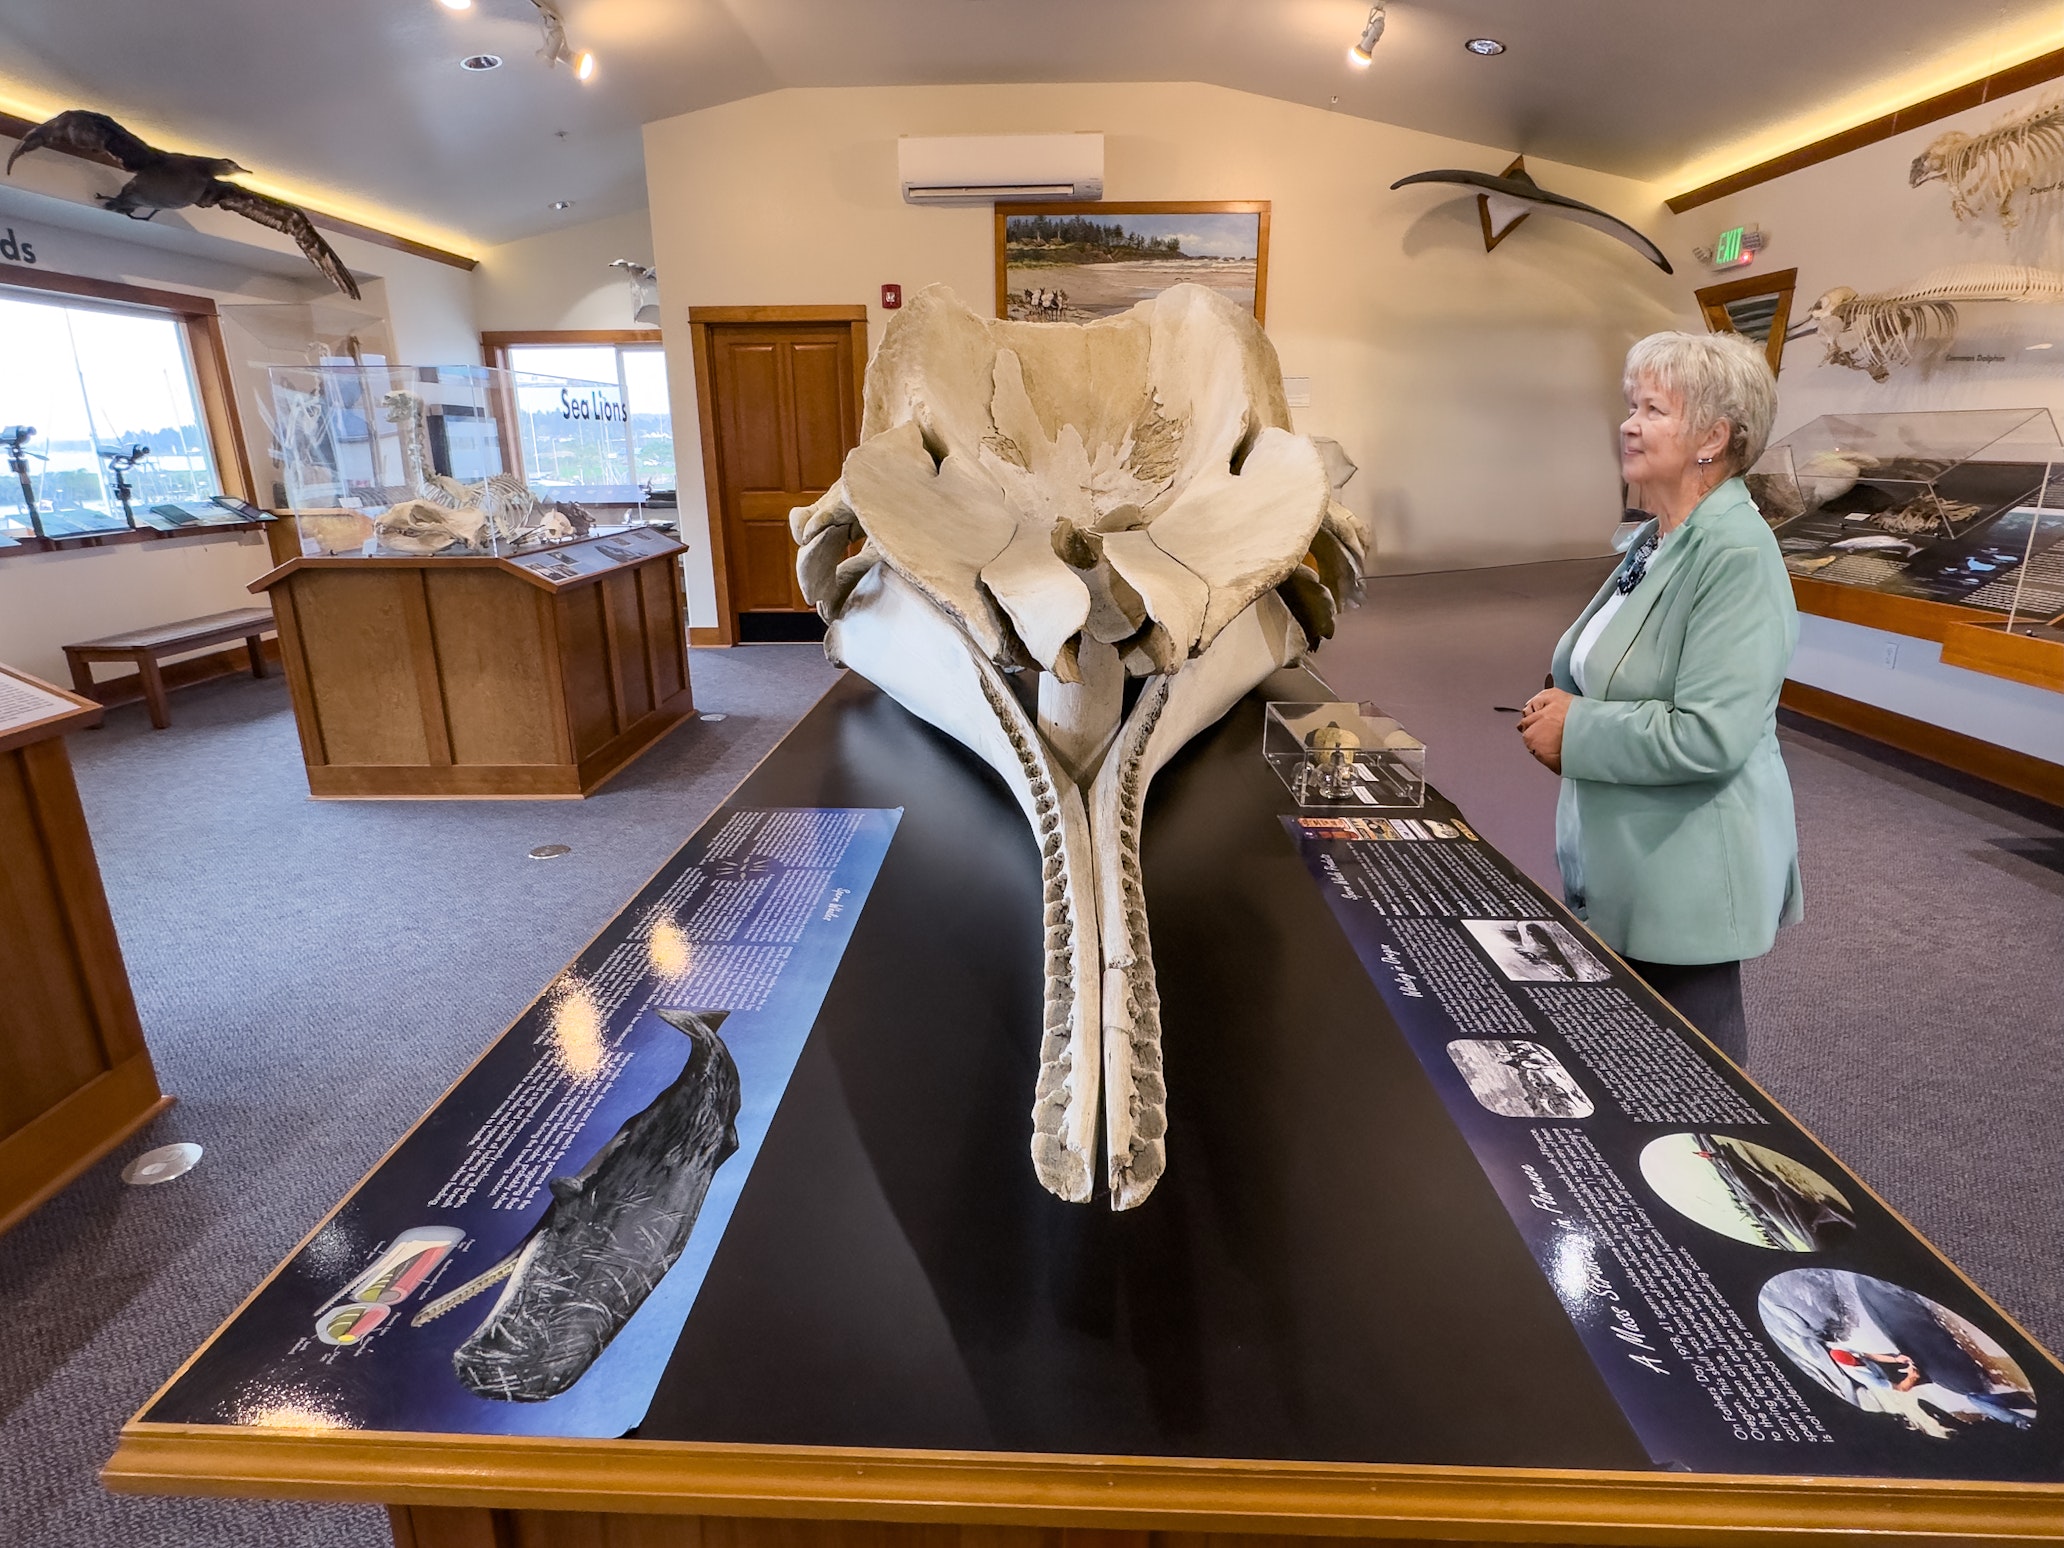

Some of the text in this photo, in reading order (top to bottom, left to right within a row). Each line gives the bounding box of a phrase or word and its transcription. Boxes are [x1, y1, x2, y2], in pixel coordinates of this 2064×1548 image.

[0, 228, 37, 264] ds
[1716, 227, 1744, 264] EXIT
[1945, 354, 2006, 364] Common Dolphin
[561, 388, 628, 423] Sea Lions
[591, 1094, 605, 1107] show
[580, 1108, 593, 1121] scars
[530, 1121, 551, 1138] during
[572, 1122, 585, 1132] that
[525, 1139, 538, 1148] the
[560, 1133, 575, 1150] match
[503, 1148, 532, 1174] breeding
[552, 1151, 565, 1160] the
[1564, 1145, 1581, 1160] years
[535, 1161, 556, 1184] patterns
[526, 1186, 541, 1198] that
[1521, 1164, 1563, 1214] Florence
[1593, 1186, 1608, 1200] from
[1608, 1188, 1627, 1205] years
[517, 1200, 531, 1210] the
[1577, 1198, 1588, 1207] on
[1605, 1202, 1619, 1214] age
[1583, 1207, 1599, 1223] alive
[1595, 1208, 1609, 1219] not
[1633, 1206, 1654, 1228] history
[1595, 1223, 1615, 1246] ashore
[1605, 1220, 1618, 1233] was
[1621, 1224, 1645, 1250] ranging
[1650, 1229, 1673, 1252] human
[1611, 1247, 1629, 1267] came
[1621, 1241, 1642, 1267] whales.
[1678, 1246, 1700, 1270] occurs.
[1640, 1252, 1664, 1277] female
[1667, 1253, 1703, 1292] throughout
[1625, 1268, 1647, 1294] whales
[1639, 1269, 1658, 1288] those
[1660, 1278, 1678, 1298] were
[1649, 1289, 1665, 1298] of
[1691, 1271, 1729, 1307] stranding
[1644, 1295, 1666, 1319] sperm
[1661, 1299, 1677, 1314] one
[1683, 1291, 1702, 1310] were
[1695, 1293, 1730, 1327] reported
[1610, 1306, 1656, 1351] Mass
[1658, 1322, 1674, 1333] 41
[1673, 1316, 1691, 1335] from
[1674, 1299, 1720, 1349] Twenty-eight
[1699, 1312, 1727, 1342] thirteen
[1726, 1309, 1746, 1330] mass
[1669, 1334, 1694, 1360] 1978,
[1687, 1336, 1704, 1354] was
[1727, 1329, 1747, 1350] been
[1749, 1340, 1768, 1358] why
[1718, 1344, 1740, 1362] and
[1744, 1352, 1765, 1374] have
[1628, 1354, 1671, 1376] A
[1691, 1363, 1709, 1382] Day
[1697, 1356, 1720, 1375] skull
[1716, 1353, 1736, 1377] alive.
[1716, 1377, 1734, 1396] This
[1734, 1364, 1767, 1397] fetuses)
[1761, 1361, 1810, 1412] understood
[1734, 1380, 1760, 1409] ocean
[1762, 1376, 1791, 1409] whales
[1733, 1398, 1765, 1440] Oregon.
[1753, 1412, 1773, 1427] the
[1764, 1400, 1800, 1442] carrying
[1789, 1412, 1817, 1442] sperm
[1805, 1415, 1825, 1431] not
[1732, 1424, 1748, 1440] On
[1771, 1431, 1783, 1441] to
[1822, 1434, 1834, 1442] is
